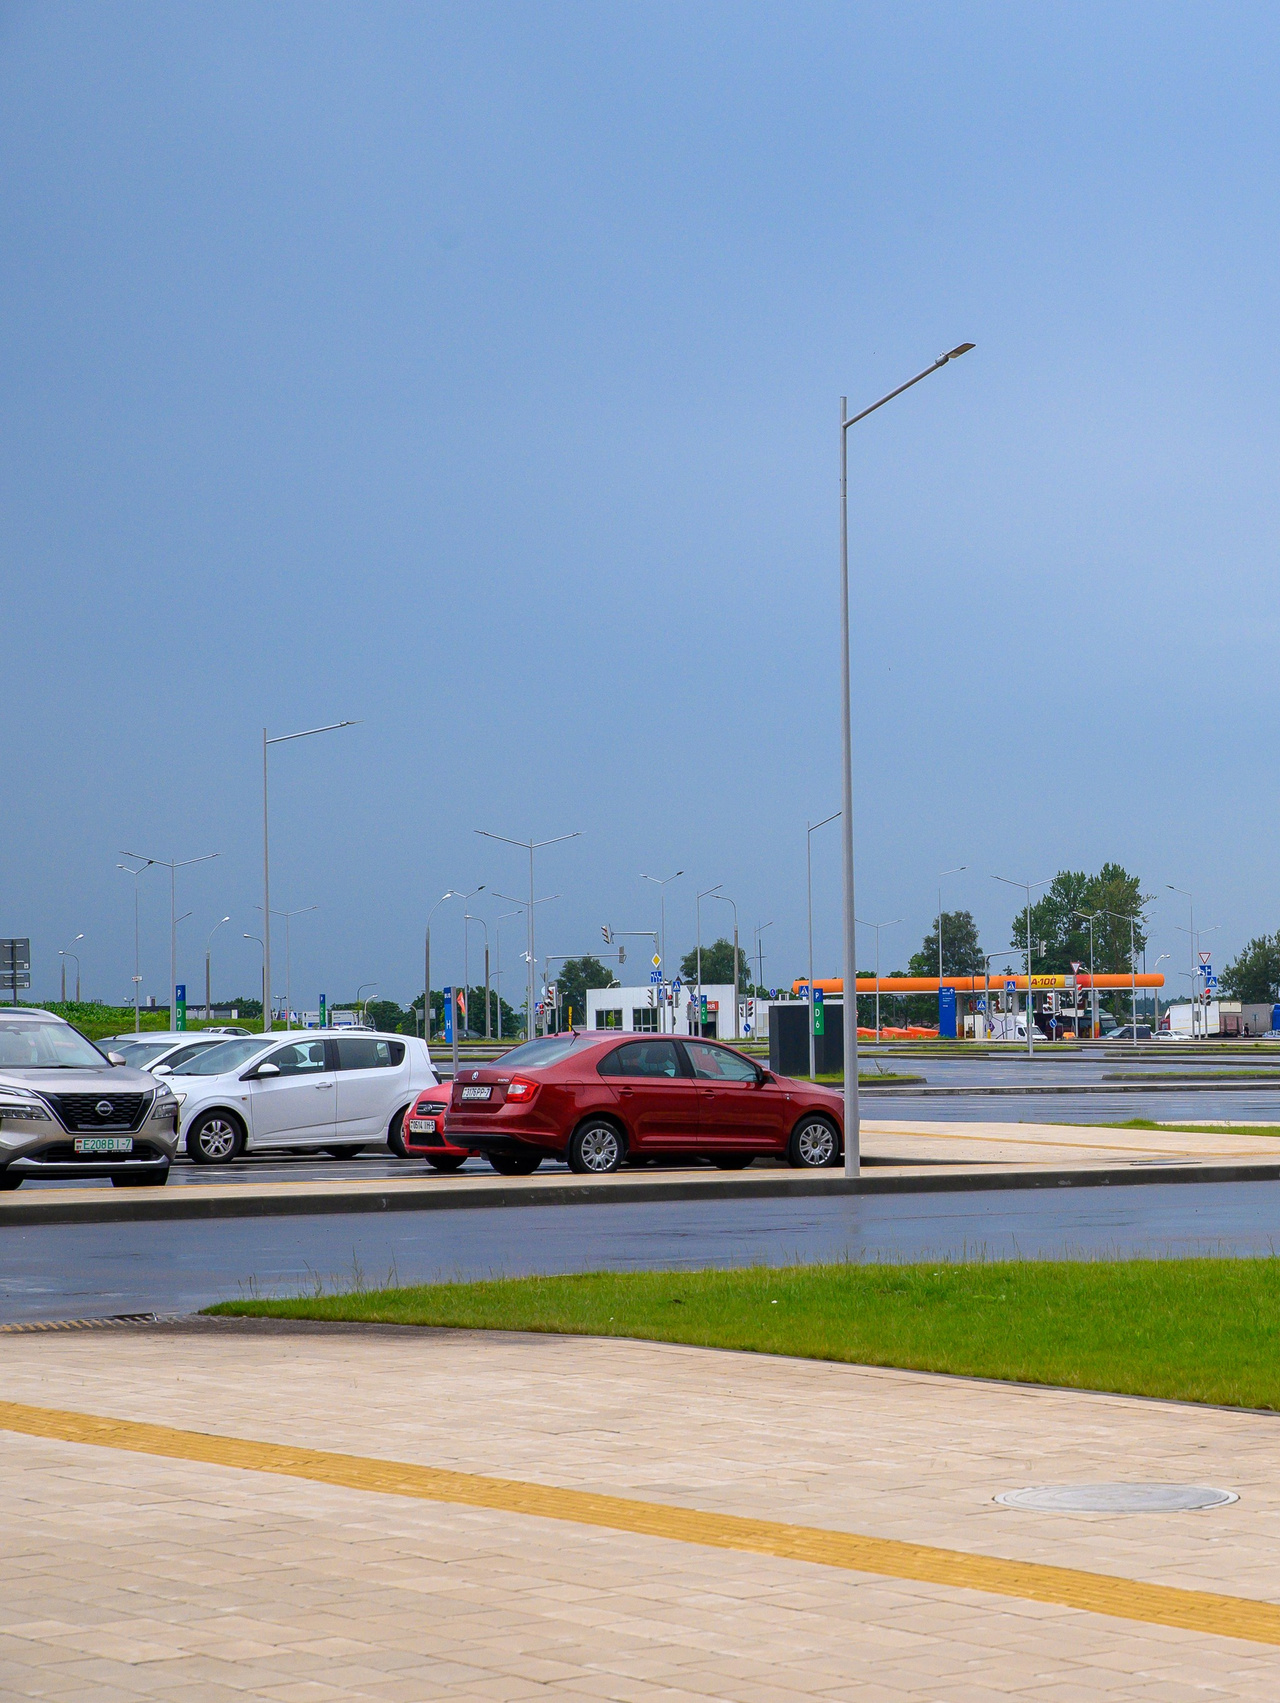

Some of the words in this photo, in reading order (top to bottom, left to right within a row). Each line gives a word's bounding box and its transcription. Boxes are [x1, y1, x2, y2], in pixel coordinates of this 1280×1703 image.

[1031, 978, 1057, 986] A-100
[177, 1008, 182, 1017] D
[815, 1009, 820, 1017] D
[816, 1020, 820, 1029] 6
